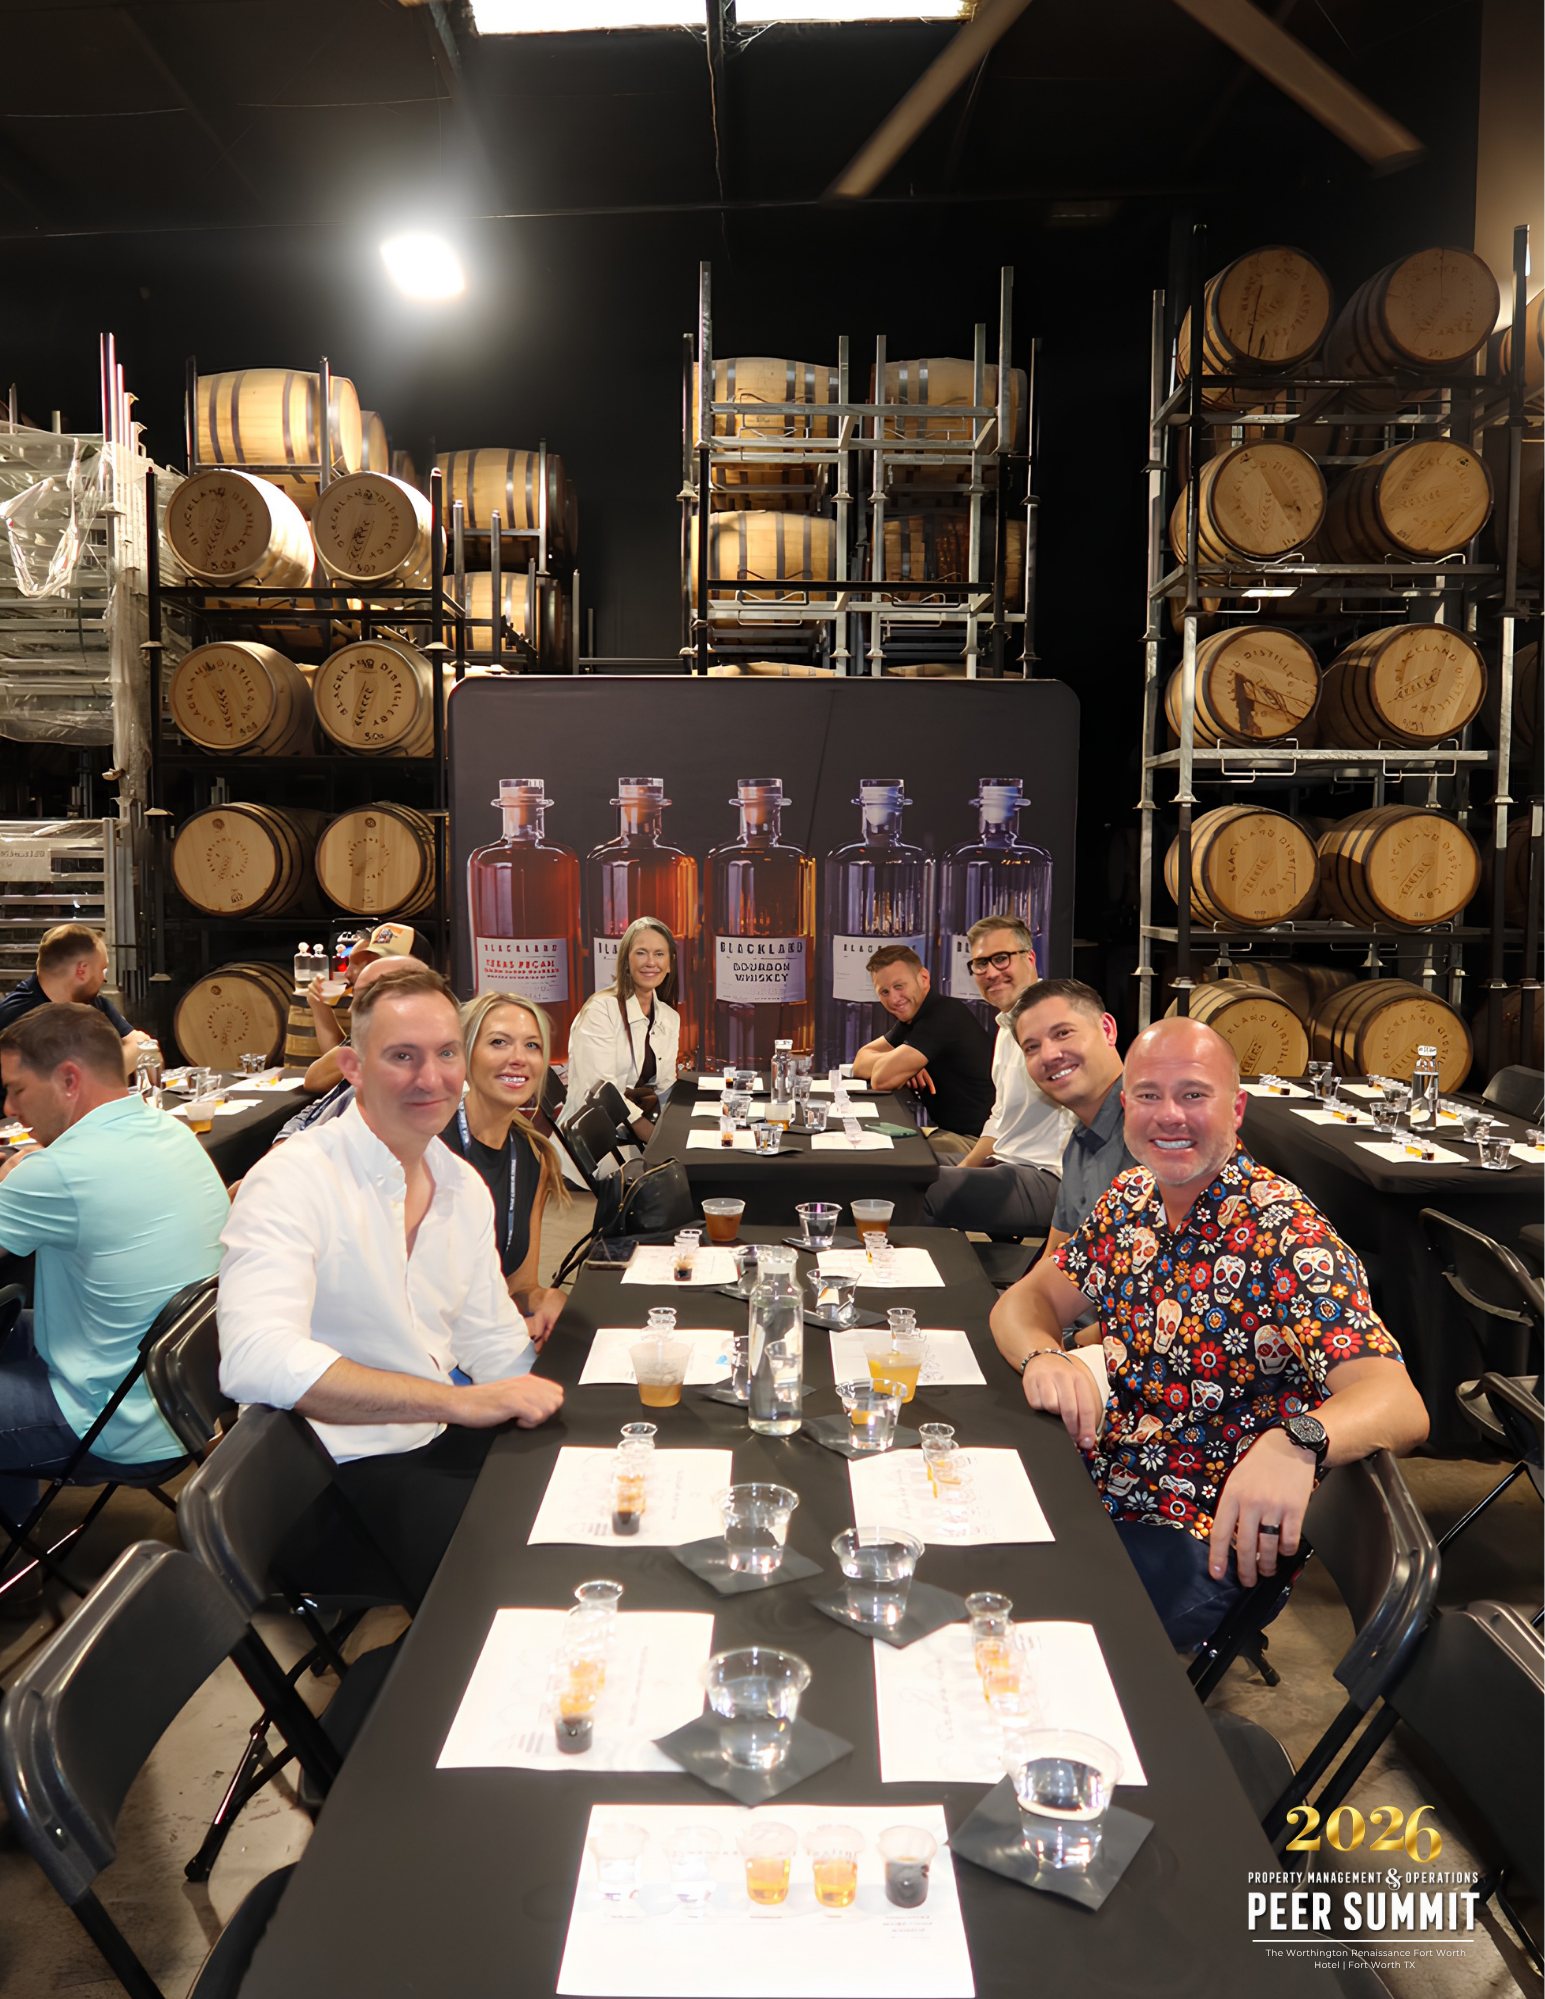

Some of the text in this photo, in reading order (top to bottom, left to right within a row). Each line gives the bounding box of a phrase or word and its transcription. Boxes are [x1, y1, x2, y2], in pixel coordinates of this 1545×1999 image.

[720, 941, 803, 954] BLACKLAND
[733, 962, 790, 972] BOURBON
[735, 973, 789, 982] WHISKEY
